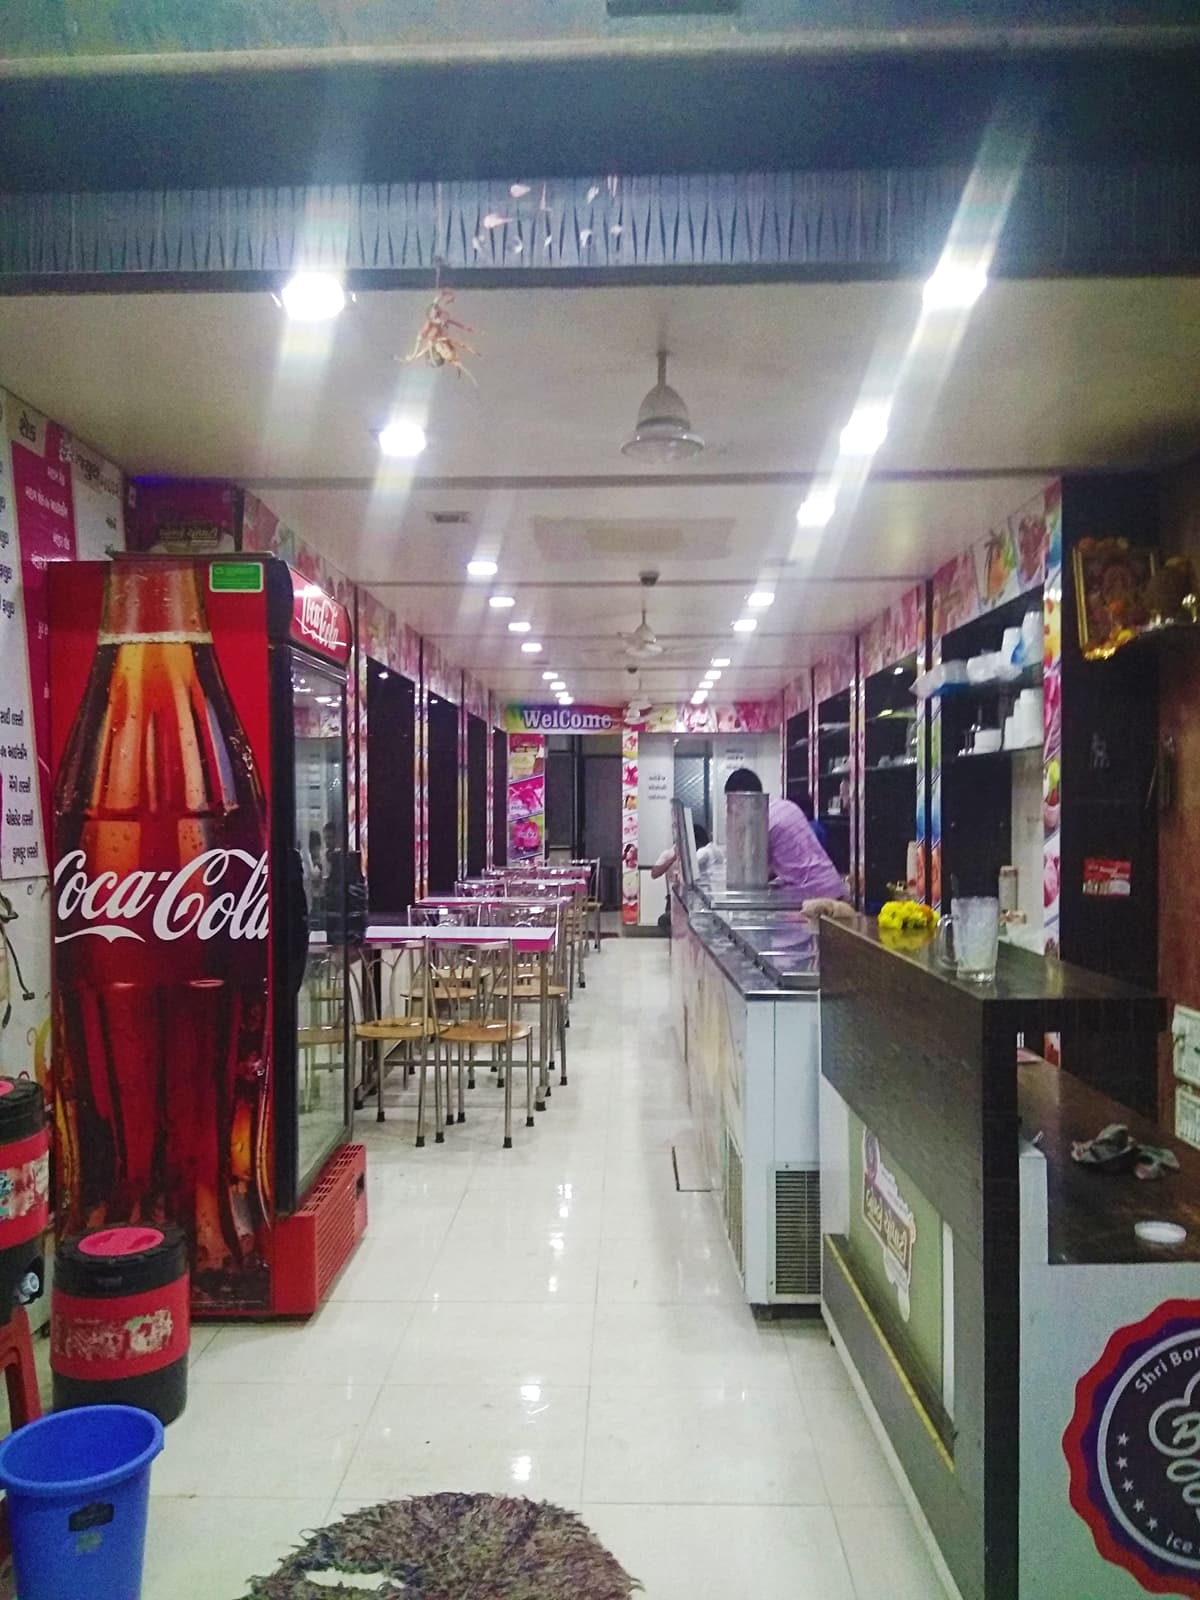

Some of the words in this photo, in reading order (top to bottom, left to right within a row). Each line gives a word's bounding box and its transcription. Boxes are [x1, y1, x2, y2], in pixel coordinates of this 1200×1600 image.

[523, 710, 612, 729] WelCome
[54, 849, 268, 940] Coca-Cola
[1135, 1359, 1168, 1394] Shri
